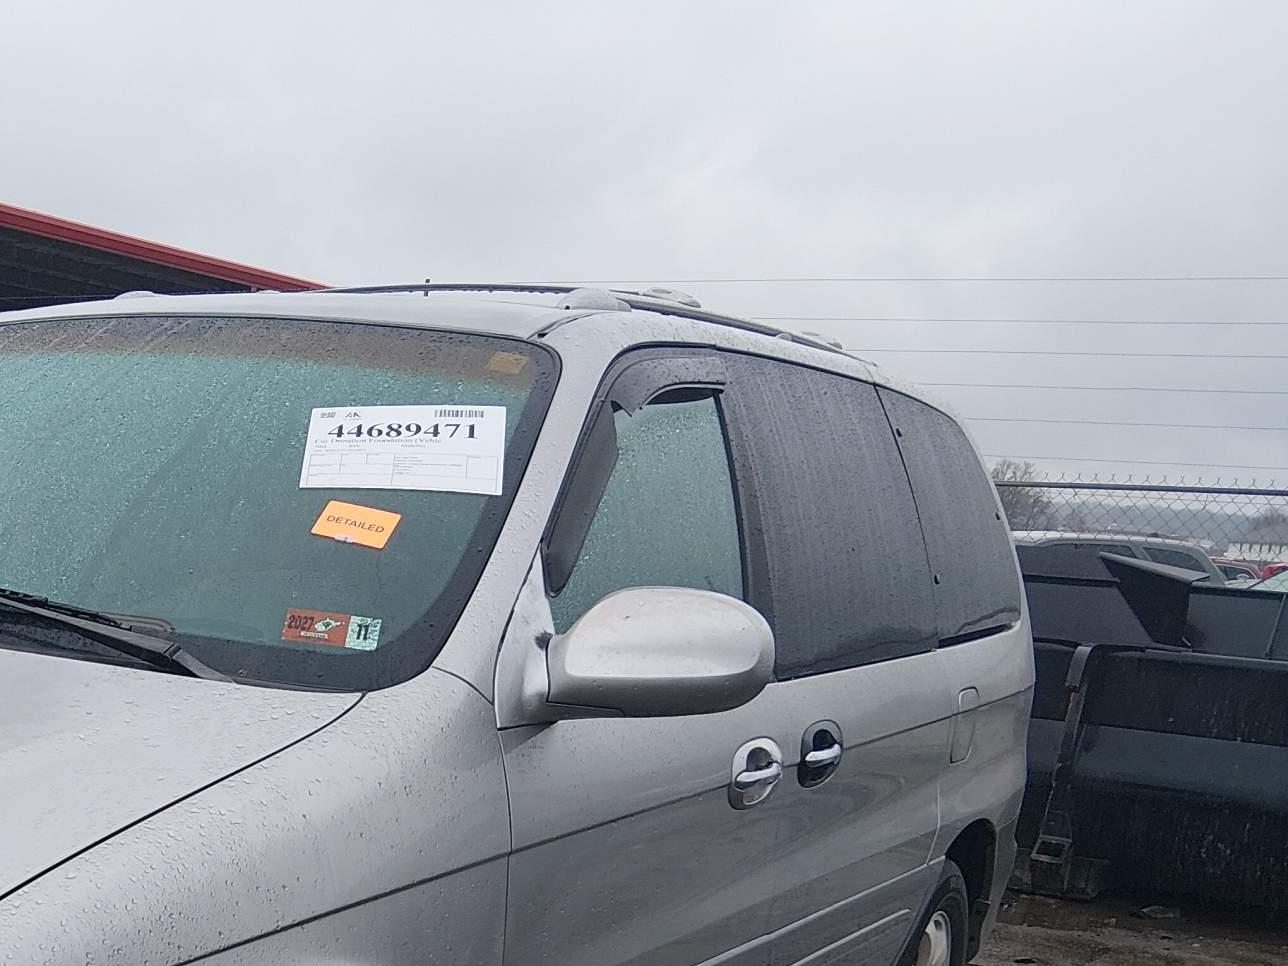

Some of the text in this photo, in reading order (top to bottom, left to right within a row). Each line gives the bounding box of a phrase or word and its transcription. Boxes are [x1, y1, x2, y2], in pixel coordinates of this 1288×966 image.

[327, 422, 479, 440] 44689471
[327, 515, 385, 533] DETAILED
[356, 623, 370, 641] 11
